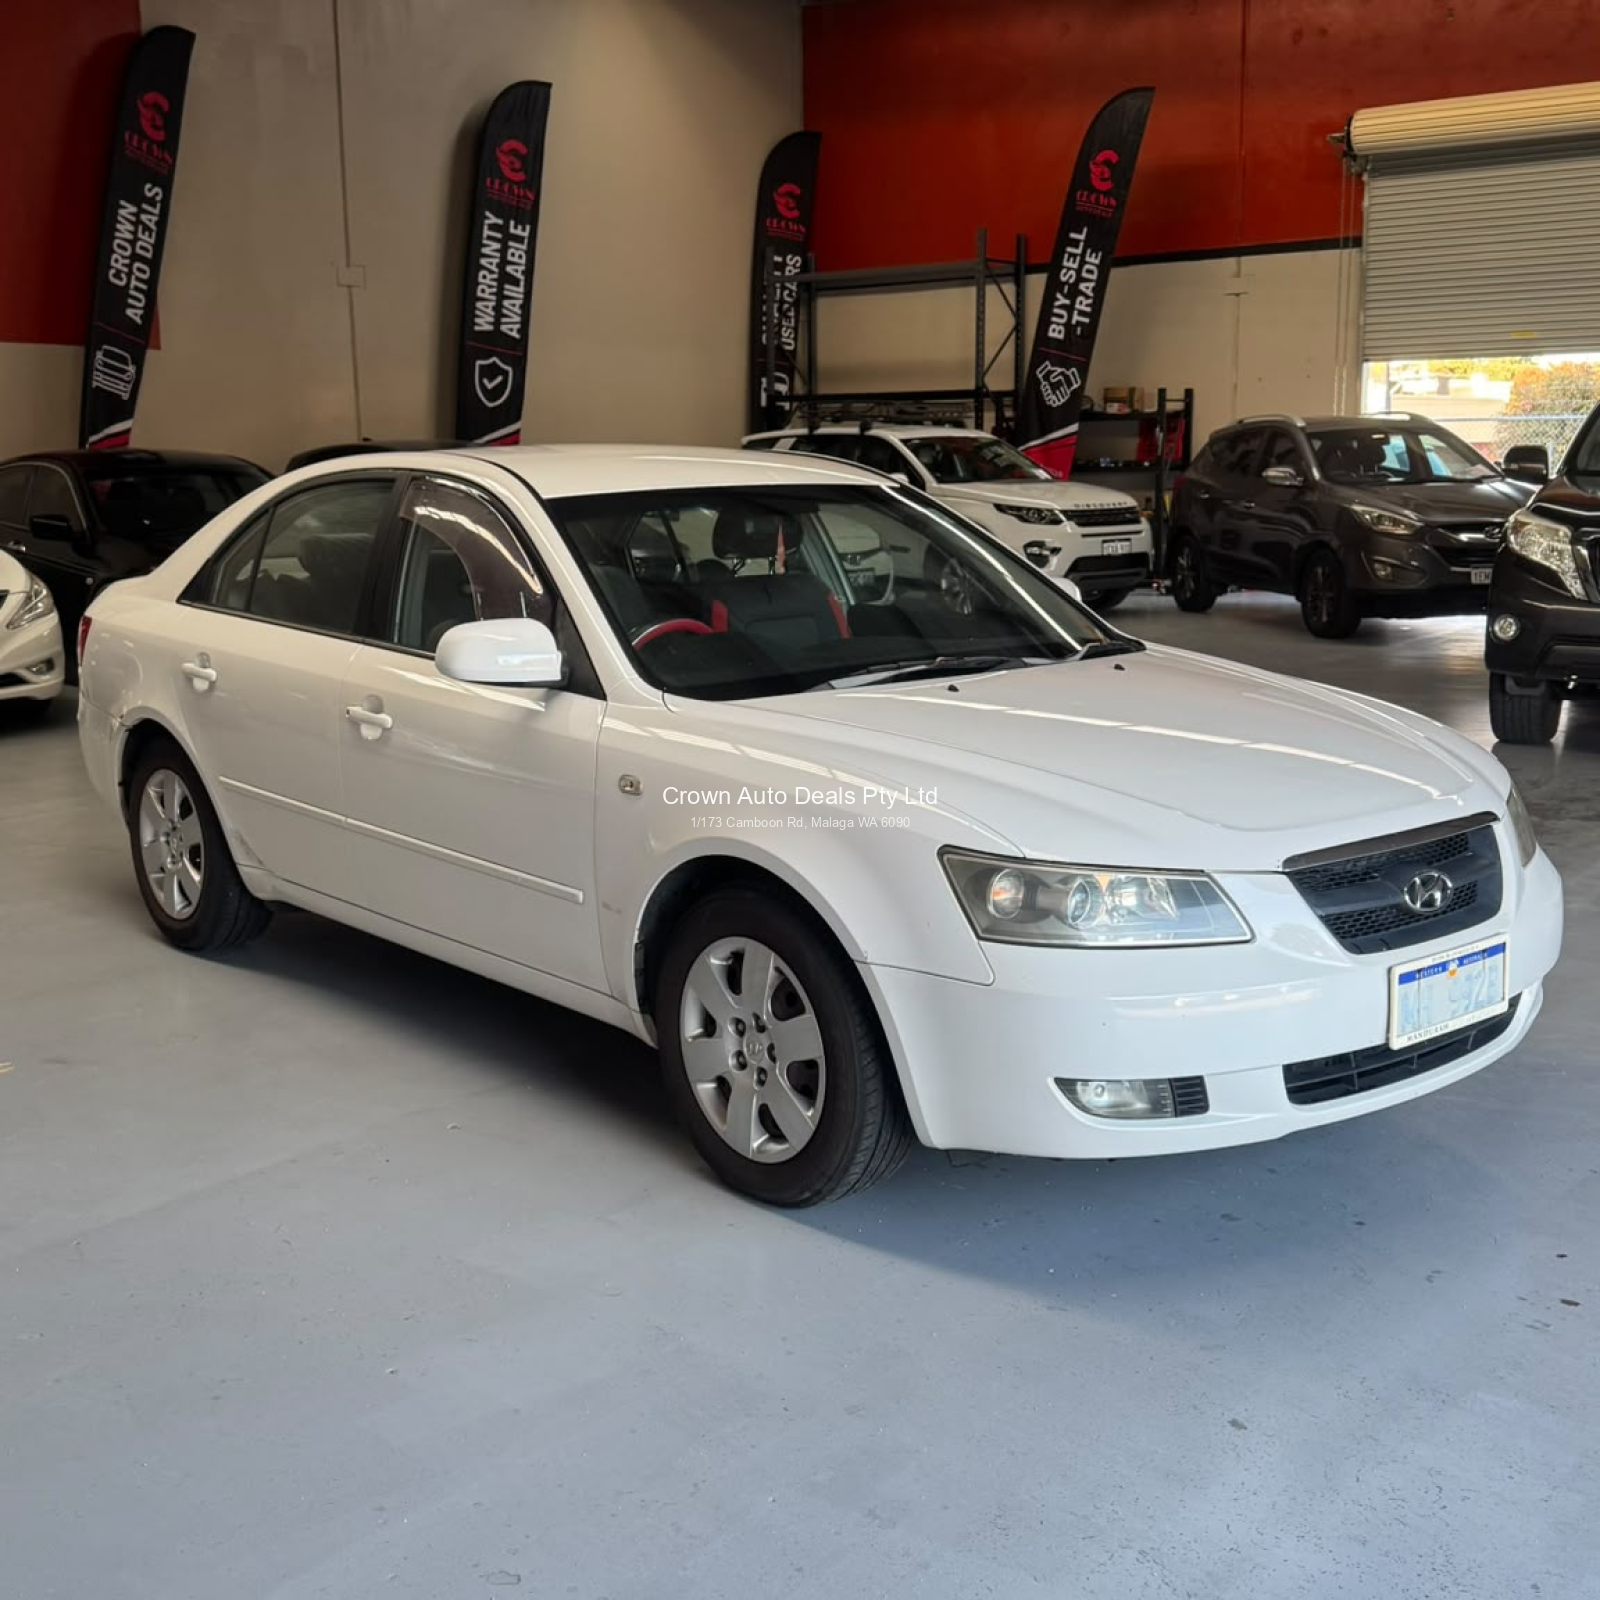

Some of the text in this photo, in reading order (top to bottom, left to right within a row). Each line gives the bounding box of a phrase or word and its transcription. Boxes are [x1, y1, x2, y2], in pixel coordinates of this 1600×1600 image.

[108, 199, 138, 287] CROWN
[136, 183, 164, 265] DEALS
[474, 210, 504, 332] WARRANTY
[125, 266, 150, 325] AUTO
[500, 220, 531, 339] AVAILABLE
[1047, 226, 1088, 340] BUY-SELL
